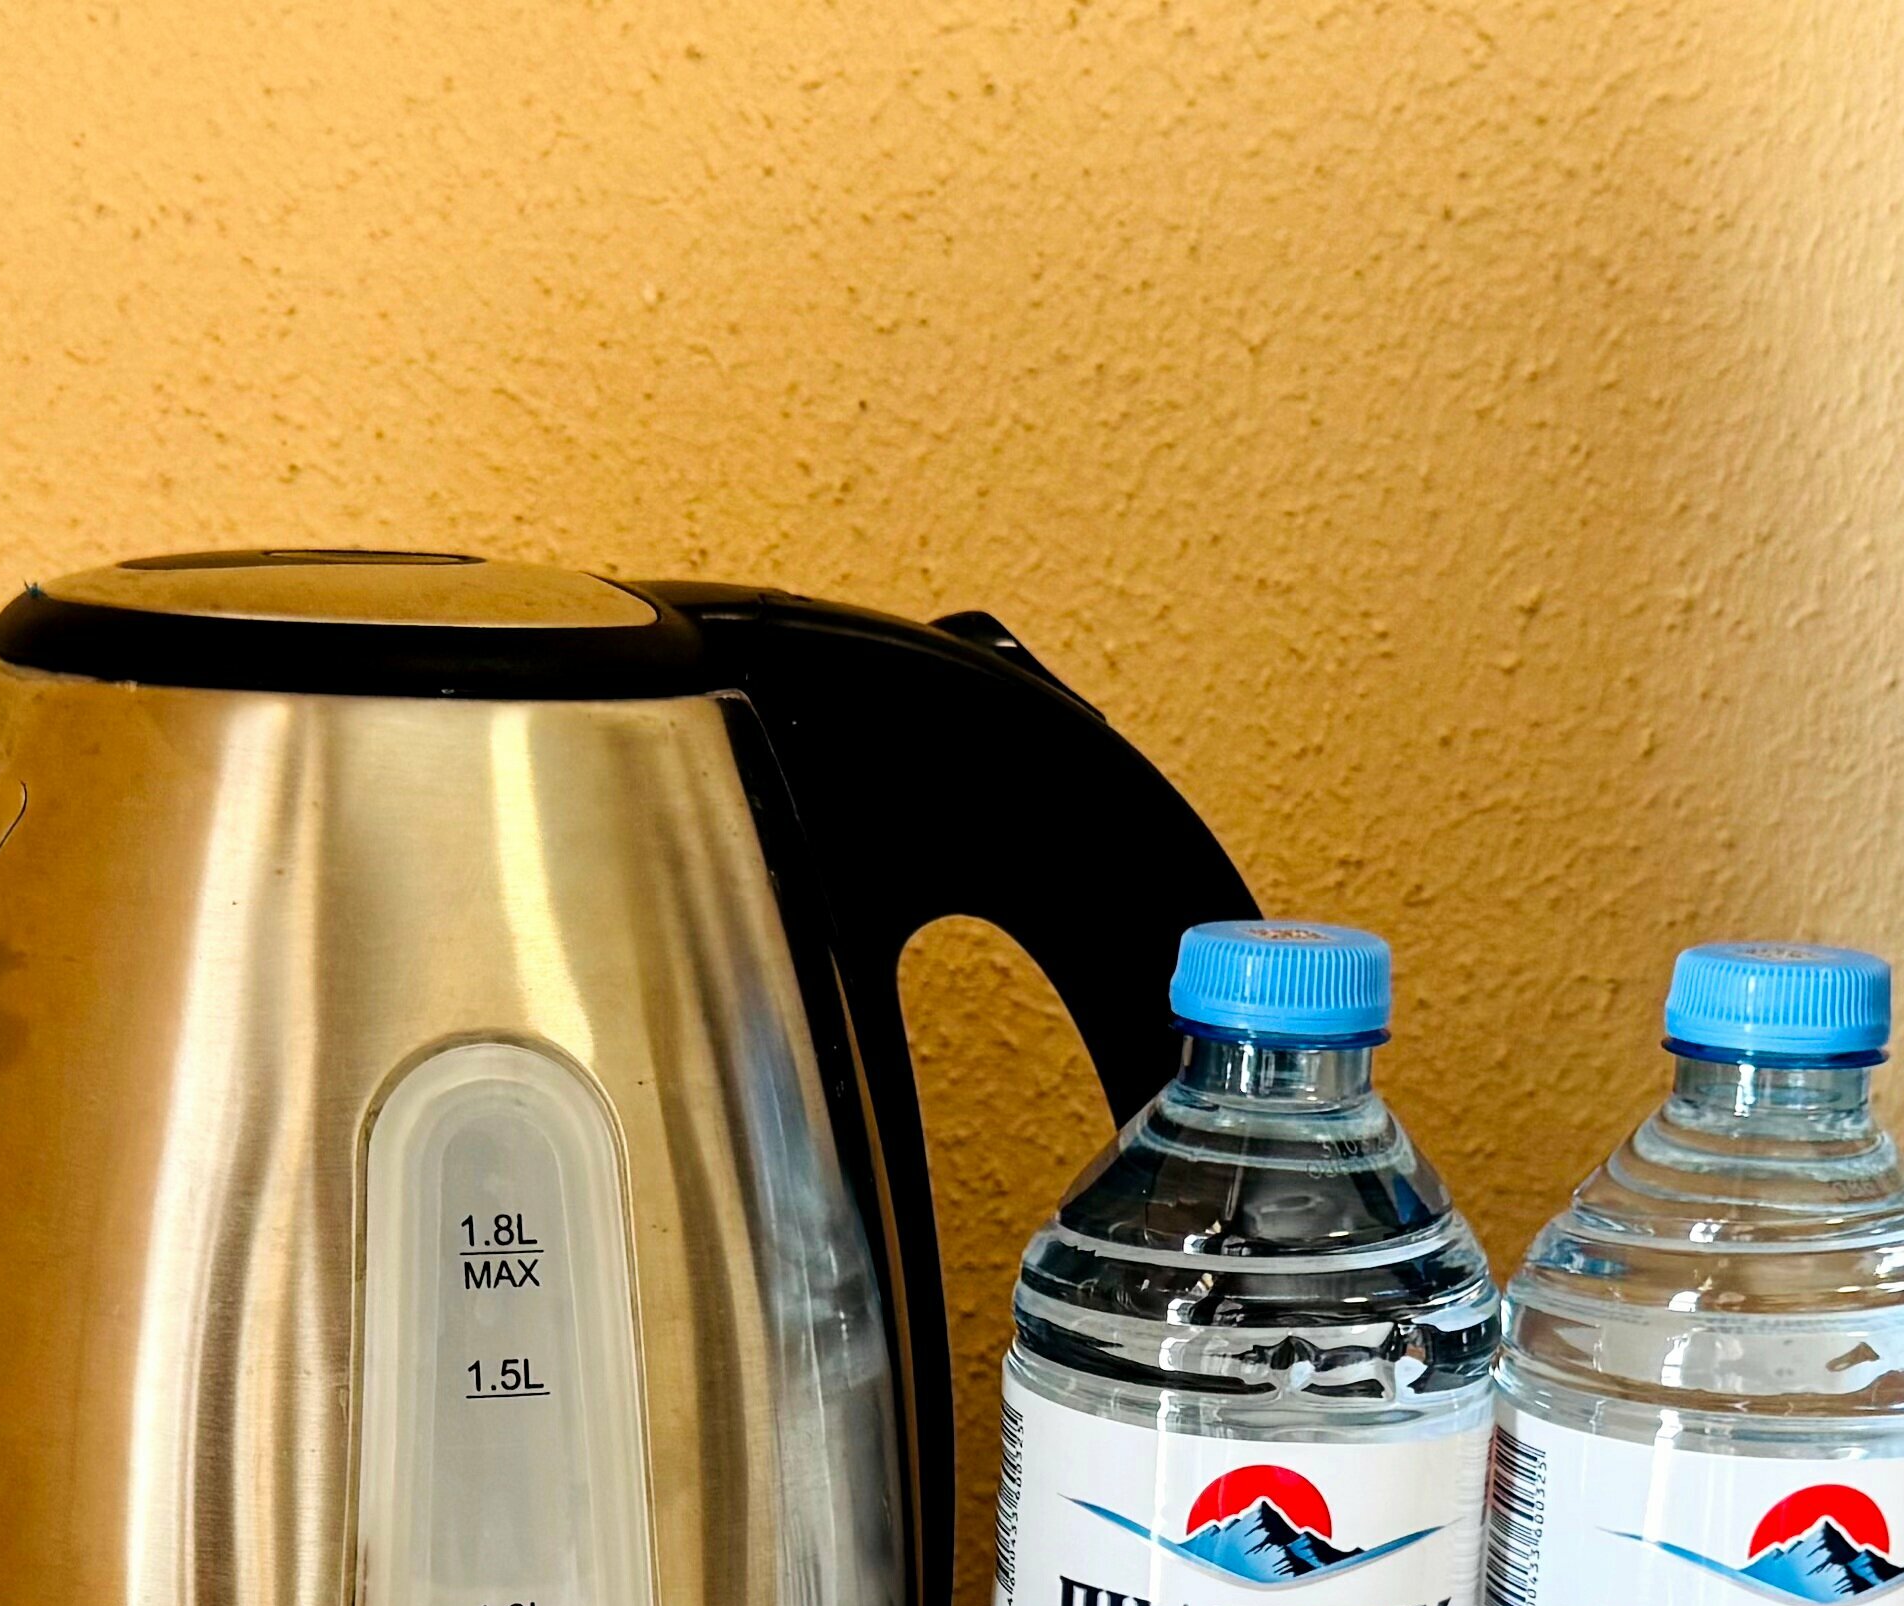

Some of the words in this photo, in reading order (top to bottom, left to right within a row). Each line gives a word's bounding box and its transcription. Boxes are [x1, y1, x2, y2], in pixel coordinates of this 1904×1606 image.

[460, 1213, 538, 1247] 1.8L
[463, 1258, 541, 1289] MAX
[466, 1358, 545, 1392] 1.5L
[1534, 1461, 1547, 1538] 600325
